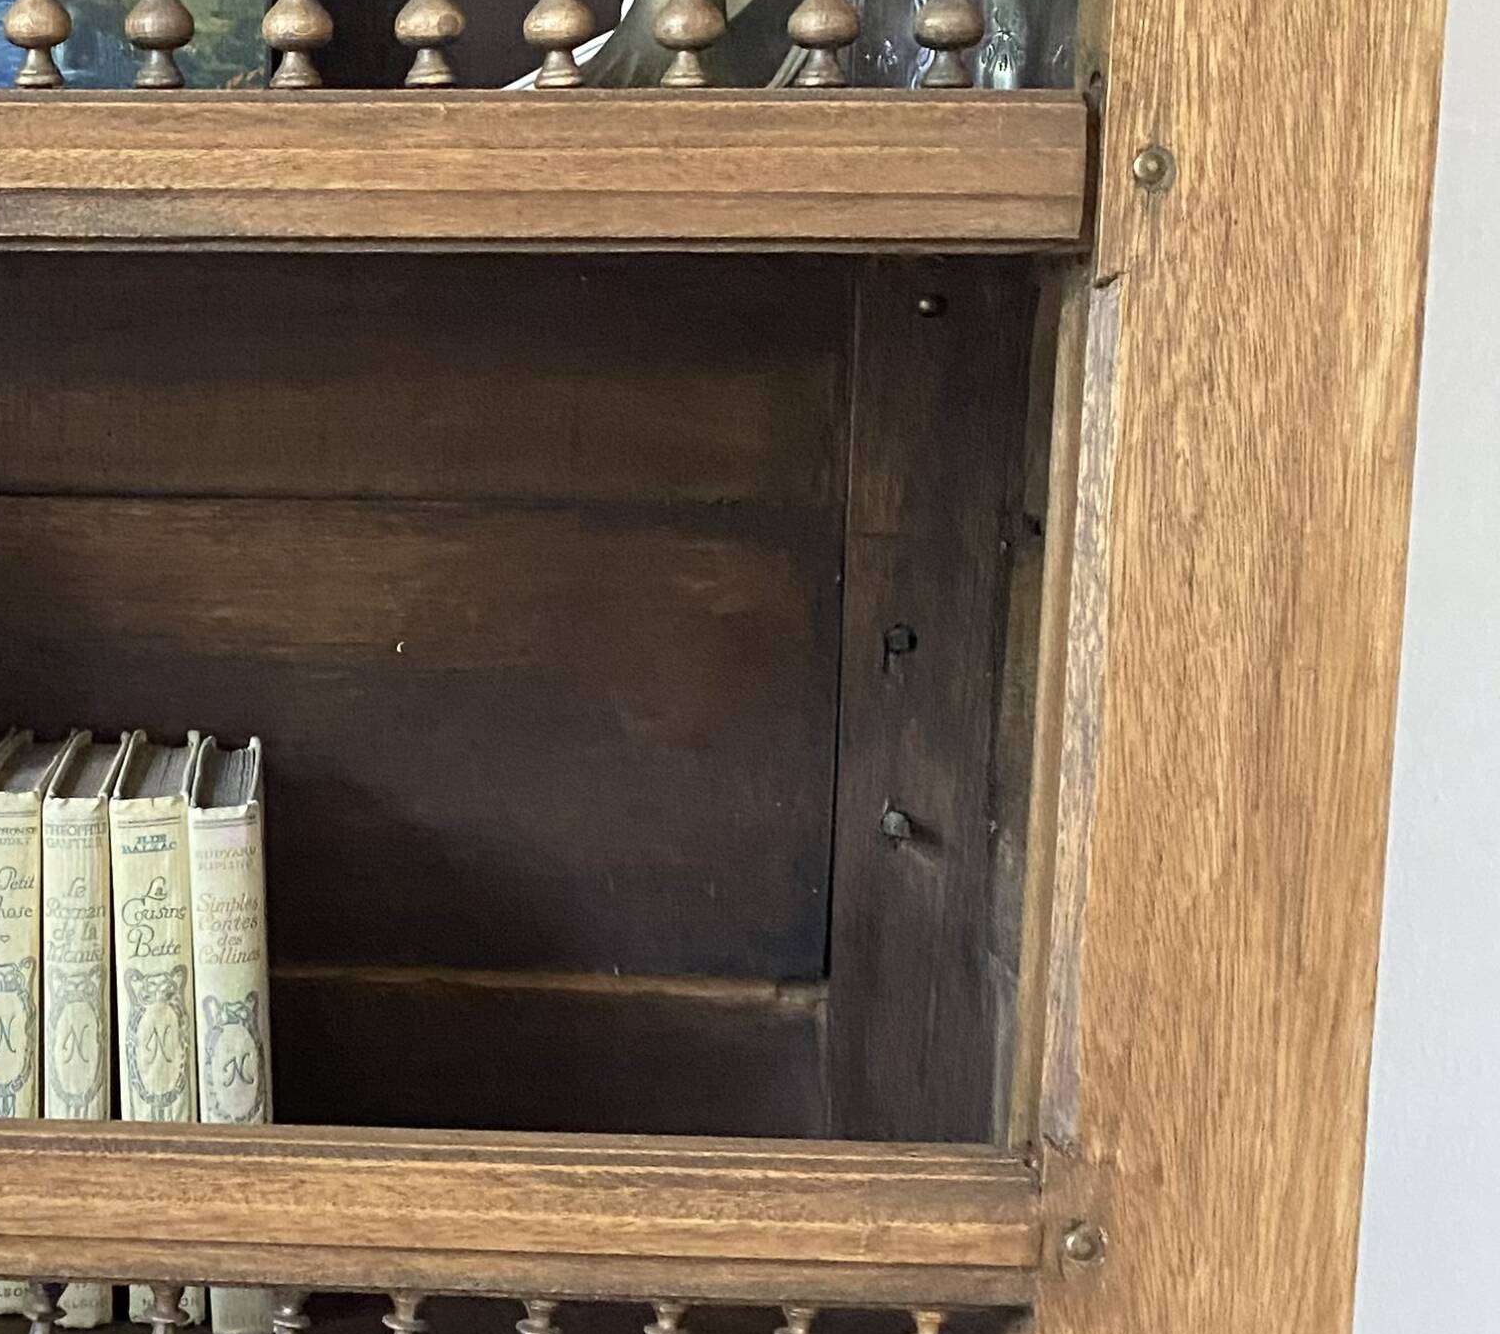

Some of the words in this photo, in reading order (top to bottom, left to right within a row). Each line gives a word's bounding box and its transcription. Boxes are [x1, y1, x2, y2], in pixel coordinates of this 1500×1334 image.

[146, 875, 168, 901] La
[121, 897, 187, 927] Cousine
[127, 924, 182, 959] Bette
[216, 931, 242, 946] des
[62, 1024, 90, 1064] N
[145, 1024, 172, 1064] N
[222, 1052, 255, 1087] N
